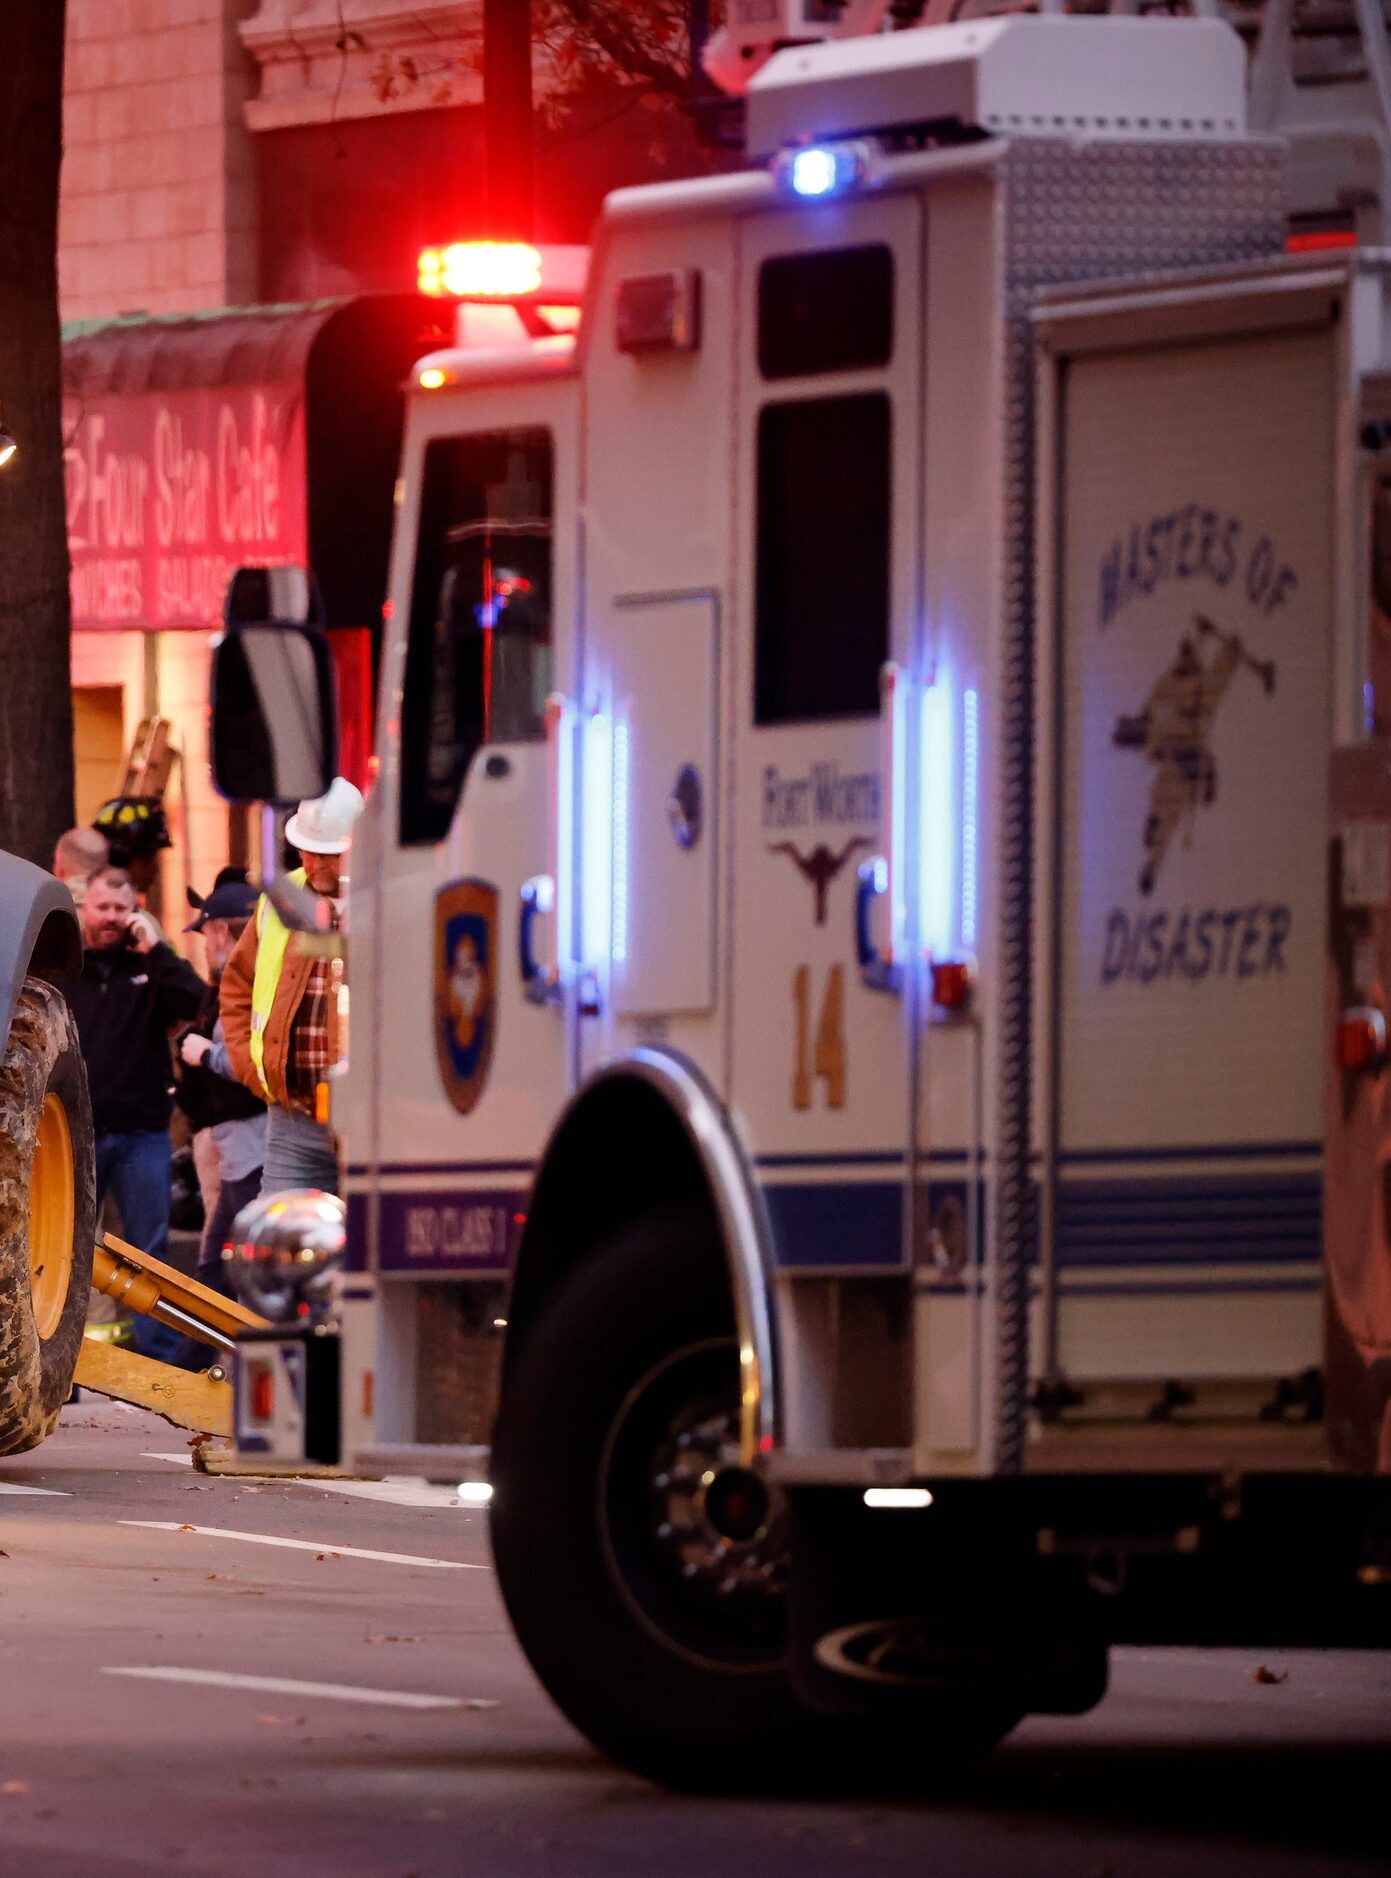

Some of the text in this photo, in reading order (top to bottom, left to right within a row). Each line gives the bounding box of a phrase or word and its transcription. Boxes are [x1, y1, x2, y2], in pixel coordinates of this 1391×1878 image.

[88, 414, 148, 548] Four
[154, 407, 210, 548] Star
[1098, 504, 1298, 630] MASTERS OF
[1101, 904, 1292, 985] DISASTER
[791, 962, 846, 1110] 14
